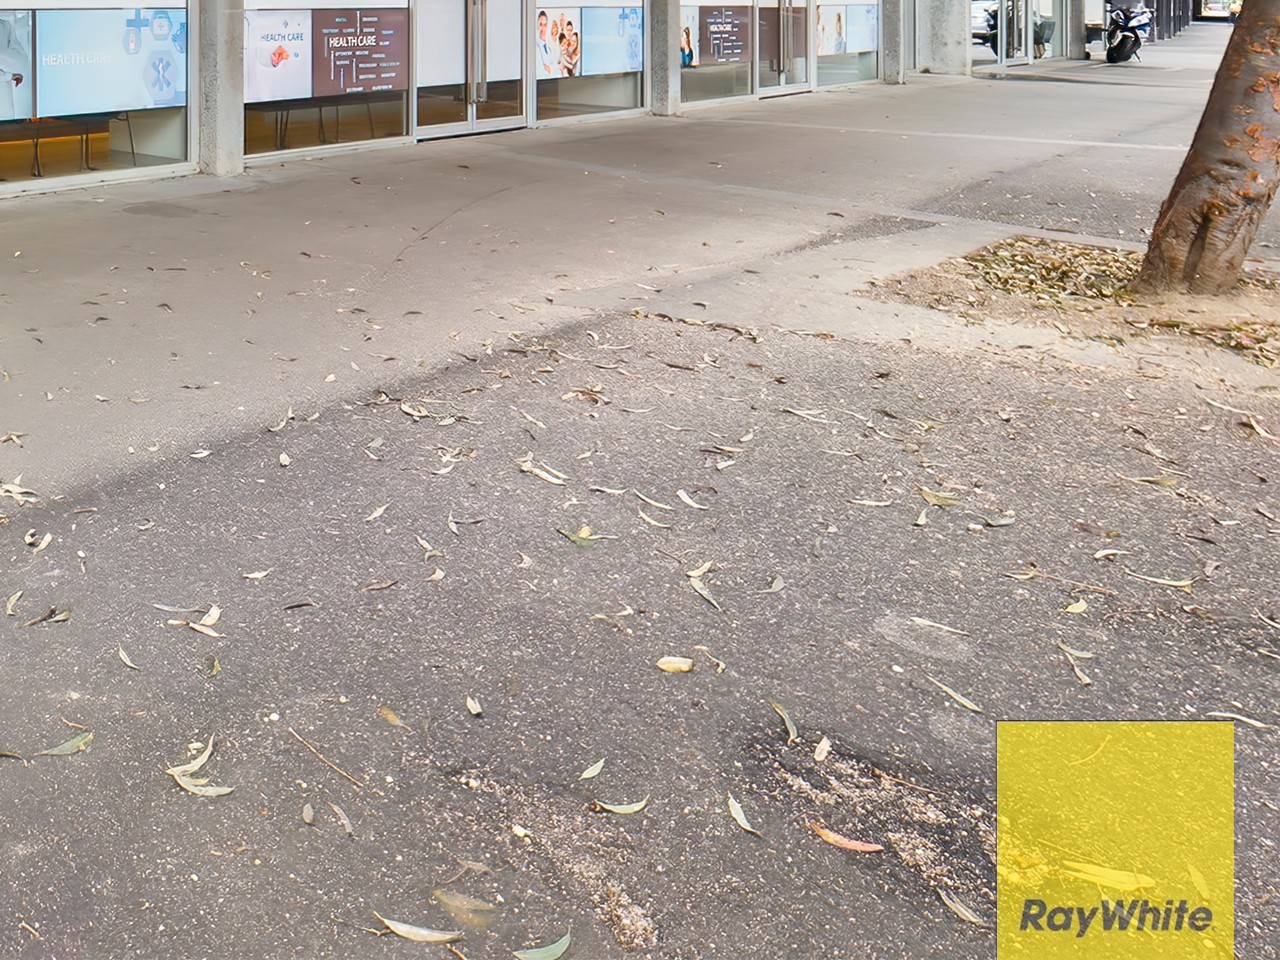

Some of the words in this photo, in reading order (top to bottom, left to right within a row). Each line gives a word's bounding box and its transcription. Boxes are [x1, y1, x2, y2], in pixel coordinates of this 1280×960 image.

[260, 33, 285, 42] HEALTH
[288, 33, 303, 41] CARE
[329, 36, 357, 47] HEALTH
[358, 36, 376, 46] CARE
